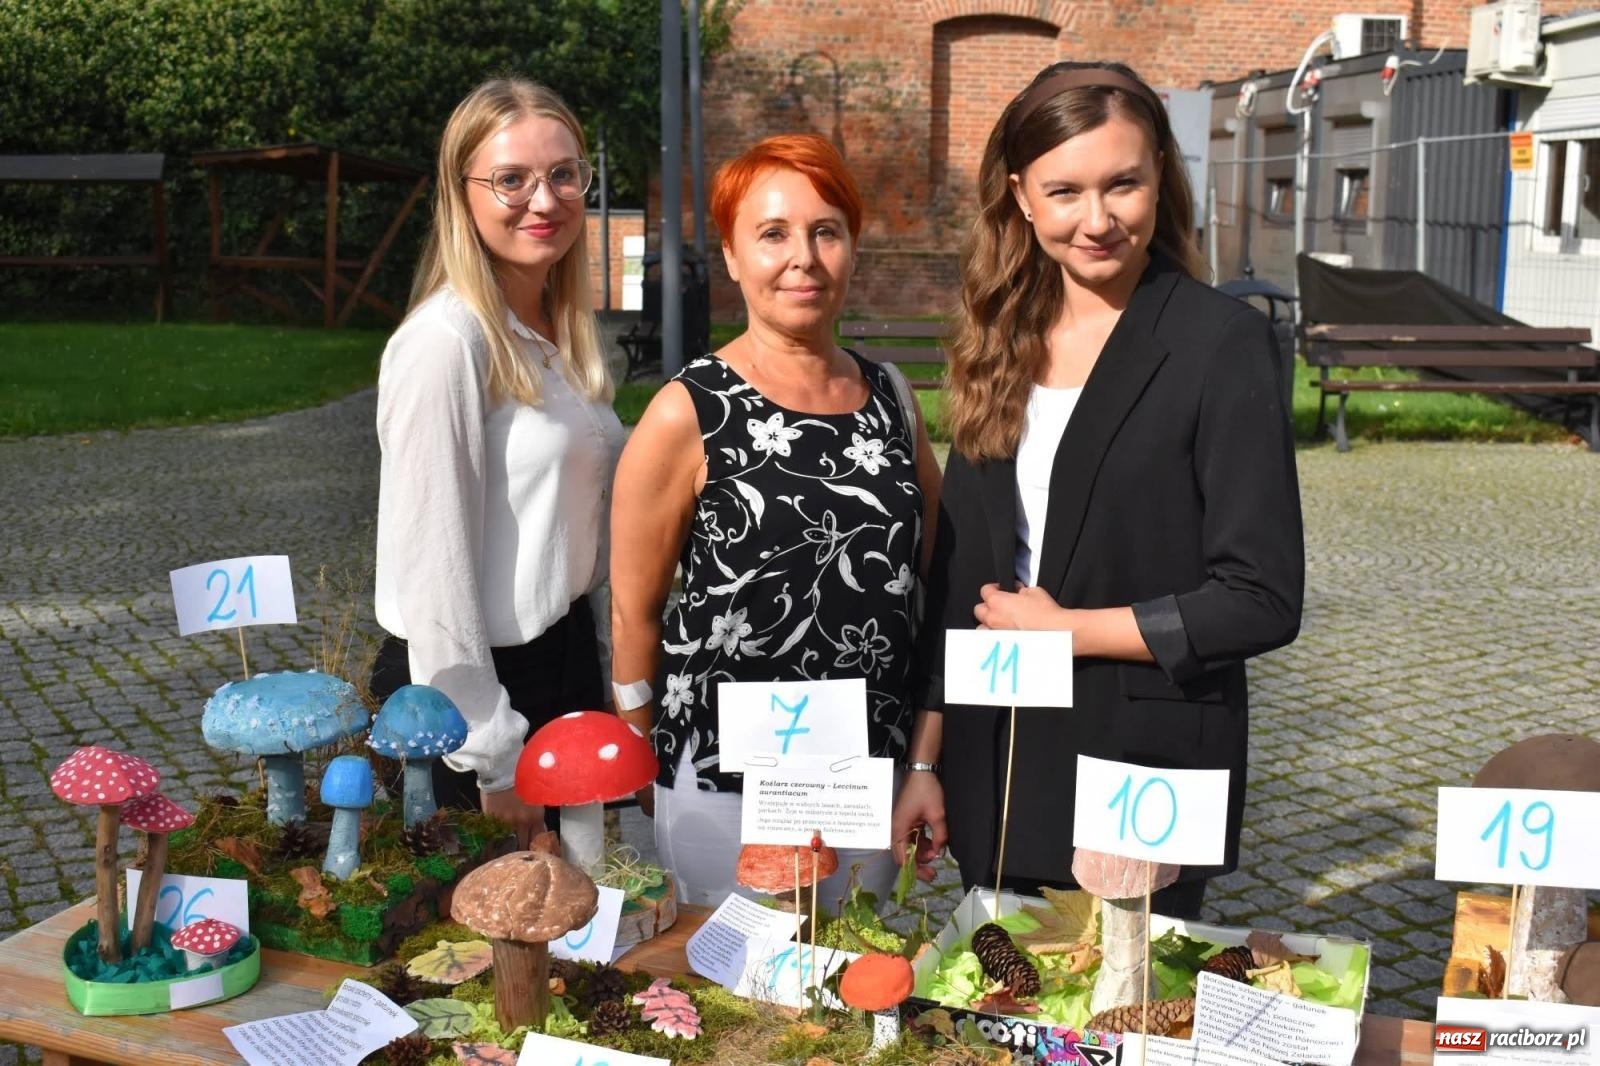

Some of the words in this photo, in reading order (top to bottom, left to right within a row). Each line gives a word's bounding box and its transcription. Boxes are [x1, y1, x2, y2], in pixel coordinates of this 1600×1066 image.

[205, 564, 257, 624] 21
[980, 641, 1019, 694] 11
[771, 692, 811, 755] 7
[759, 789, 808, 797] aurantiacum
[833, 782, 868, 790] Leccinum
[1107, 774, 1178, 847] 10
[1480, 800, 1555, 871] 19
[159, 885, 215, 928] 26
